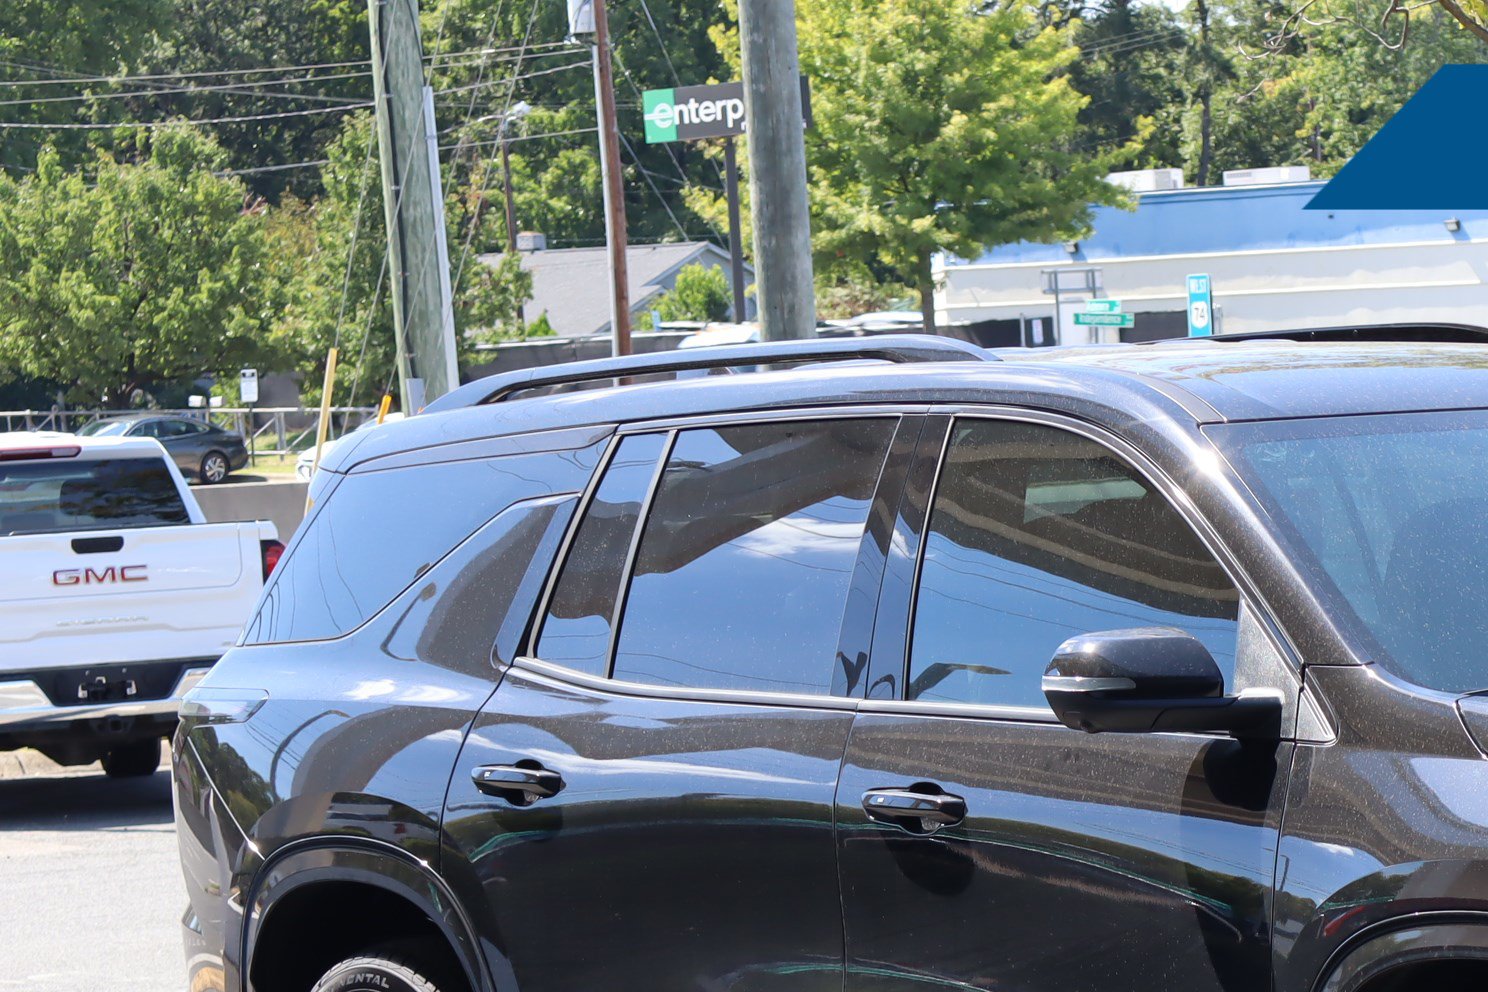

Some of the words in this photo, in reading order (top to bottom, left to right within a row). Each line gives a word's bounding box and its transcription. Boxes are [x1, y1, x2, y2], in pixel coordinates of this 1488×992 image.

[644, 97, 744, 129] enterp
[1193, 306, 1206, 322] 74
[52, 564, 149, 587] GMC
